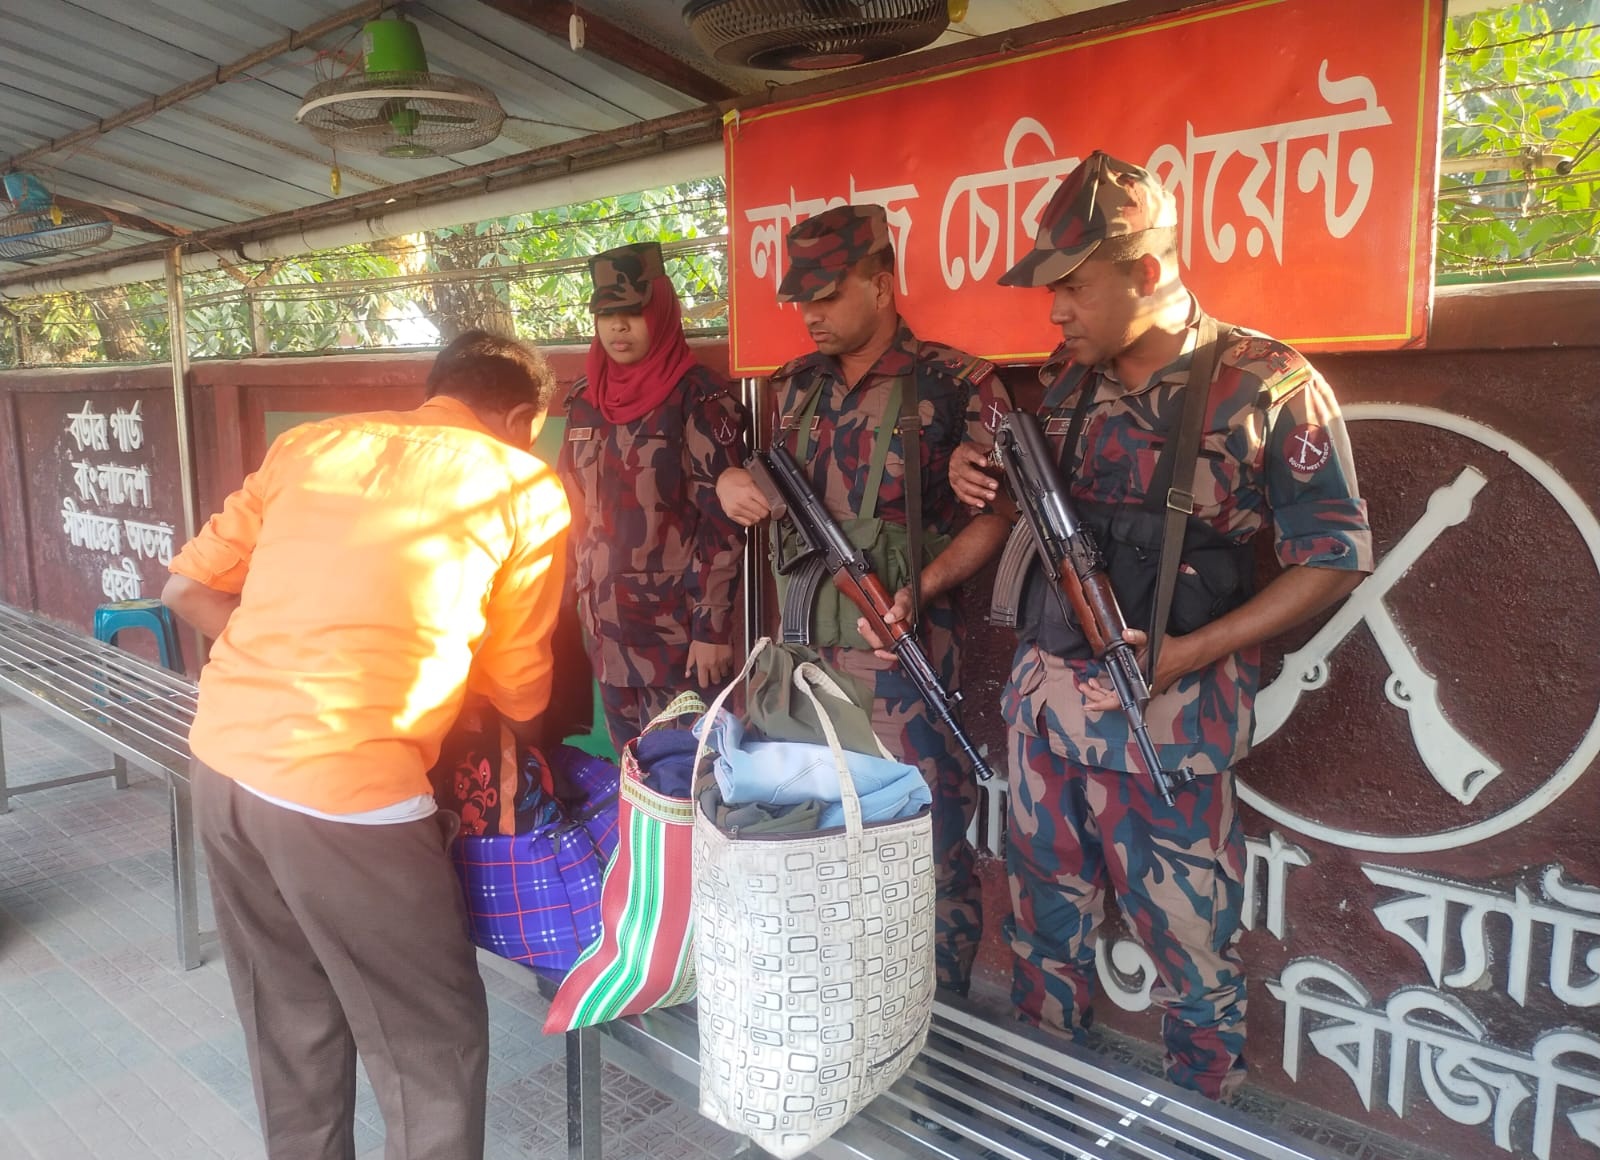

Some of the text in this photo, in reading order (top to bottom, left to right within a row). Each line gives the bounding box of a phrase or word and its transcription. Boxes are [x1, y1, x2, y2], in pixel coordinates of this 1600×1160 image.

[66, 399, 145, 452] বর্ডার গার্ড
[71, 459, 151, 508] বাংলাদেশ
[1289, 457, 1306, 471] SOUTH
[1306, 462, 1321, 471] WEST
[61, 497, 120, 555] সীমান্তের
